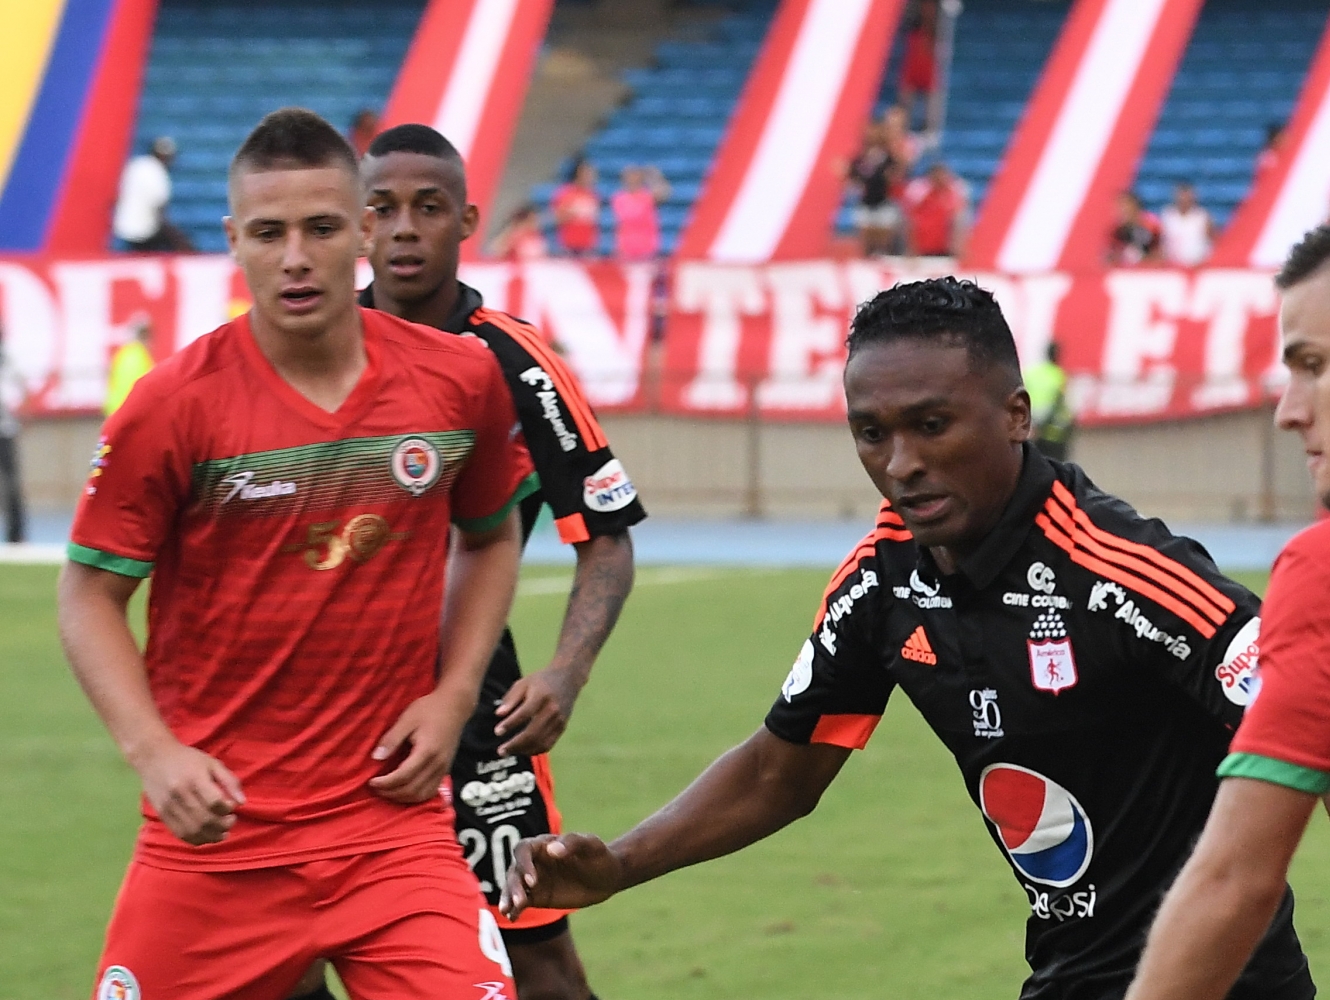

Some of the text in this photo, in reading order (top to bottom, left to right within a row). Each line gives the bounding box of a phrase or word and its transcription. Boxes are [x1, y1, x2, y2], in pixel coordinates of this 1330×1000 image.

[1002, 592, 1029, 607] CINE
[1110, 599, 1192, 661] Alquería
[901, 647, 937, 666] adidas
[1215, 643, 1260, 688] Supe
